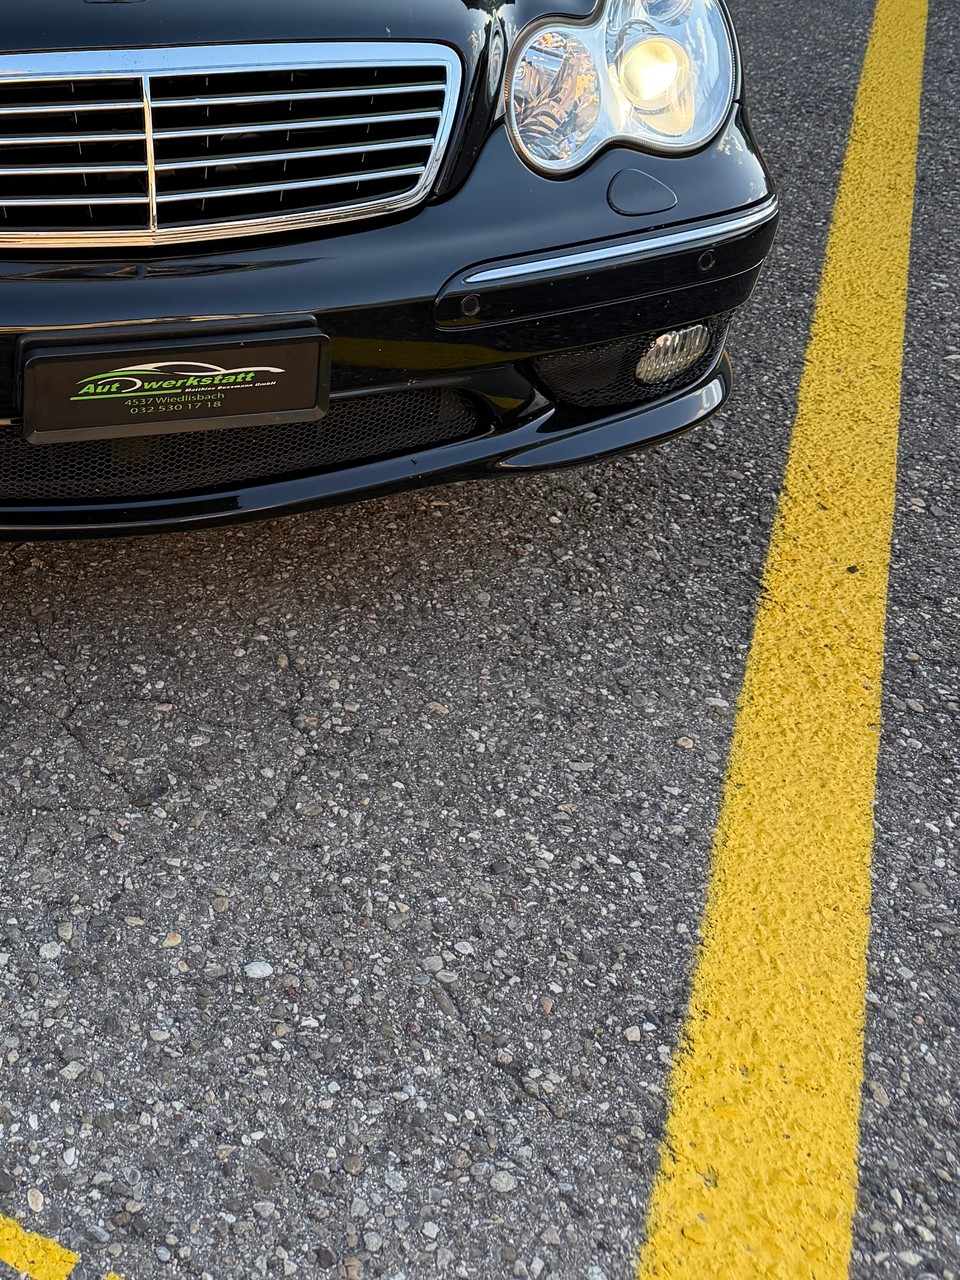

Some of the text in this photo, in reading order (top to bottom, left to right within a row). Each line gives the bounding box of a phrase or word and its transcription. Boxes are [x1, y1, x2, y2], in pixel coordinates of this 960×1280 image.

[124, 391, 225, 406] 4537 Wiedlisbach
[130, 400, 222, 415] 032 530 17 18
